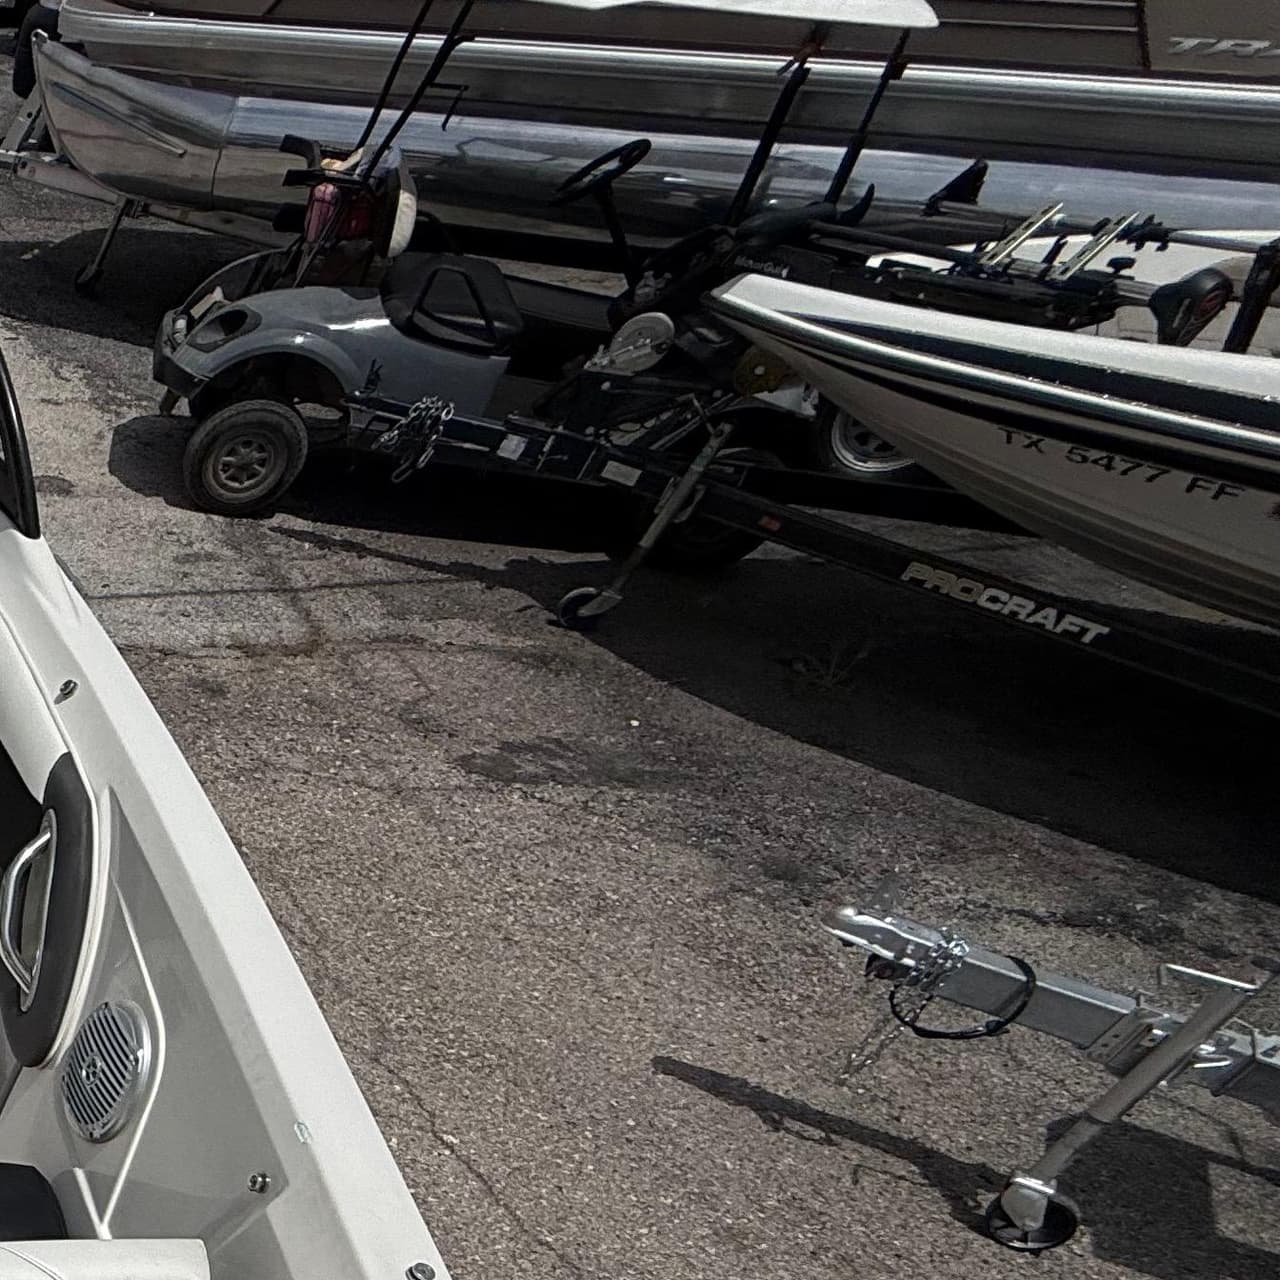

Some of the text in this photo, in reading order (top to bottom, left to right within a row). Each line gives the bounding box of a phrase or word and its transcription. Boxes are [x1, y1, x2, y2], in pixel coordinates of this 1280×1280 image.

[1167, 36, 1280, 58] TR
[998, 427, 1246, 501] TX 5477 FF
[900, 560, 1112, 644] PROCRAFT
